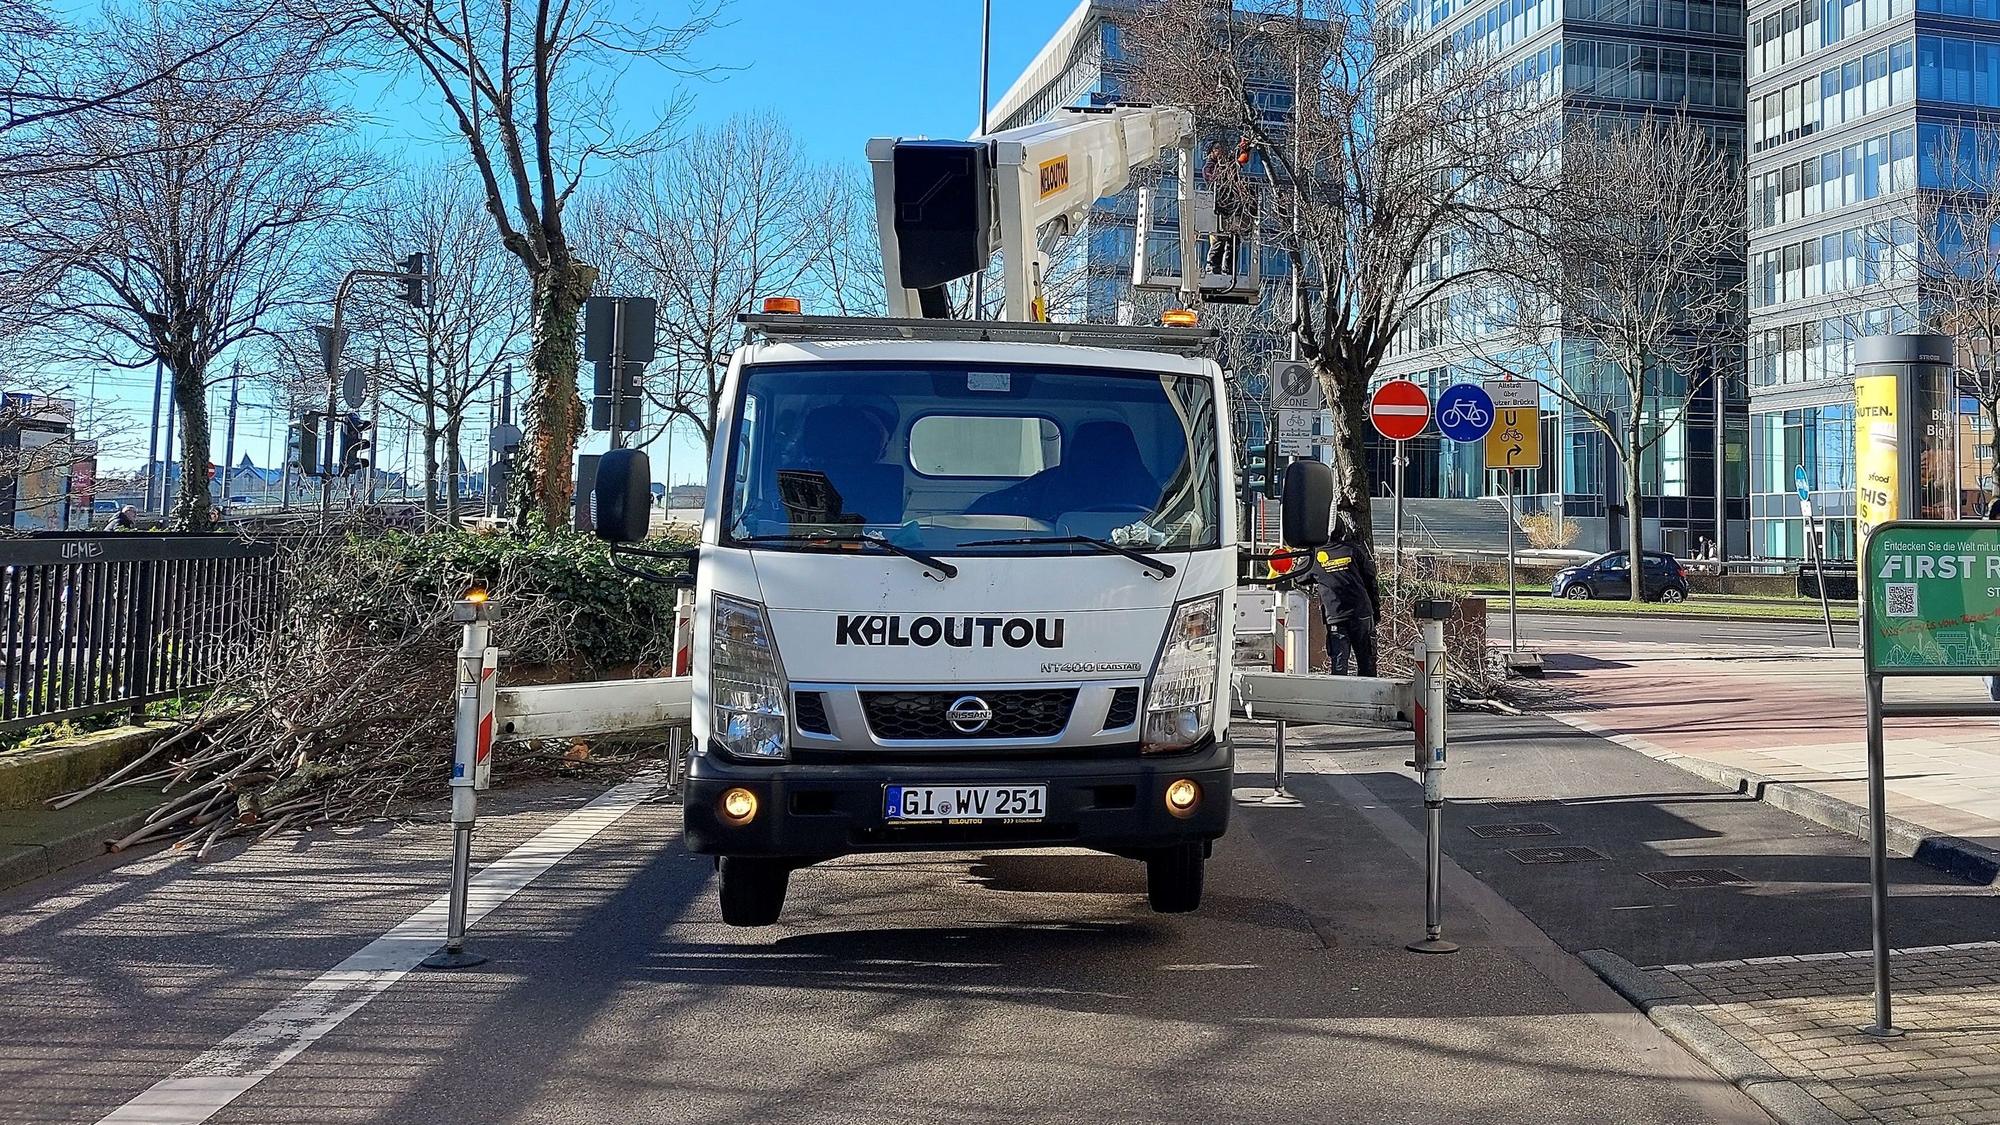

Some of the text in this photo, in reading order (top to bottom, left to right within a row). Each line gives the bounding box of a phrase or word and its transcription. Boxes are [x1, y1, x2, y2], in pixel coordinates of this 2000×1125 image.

[1505, 410, 1517, 426] U
[1861, 487, 1887, 506] THIS
[1859, 503, 1868, 518] IS
[1884, 541, 1926, 551] Entdecken
[1928, 541, 1941, 551] Sie
[1943, 541, 1955, 551] die
[1957, 541, 1975, 551] Welt
[1977, 541, 1990, 551] mit
[1878, 555, 1977, 579] FIRST
[835, 614, 1065, 649] KILOUTOU
[1040, 661, 1095, 673] NT400
[950, 711, 989, 720] NISSAN
[902, 790, 935, 815] GI
[955, 789, 989, 815] WV
[995, 789, 1043, 814] 251
